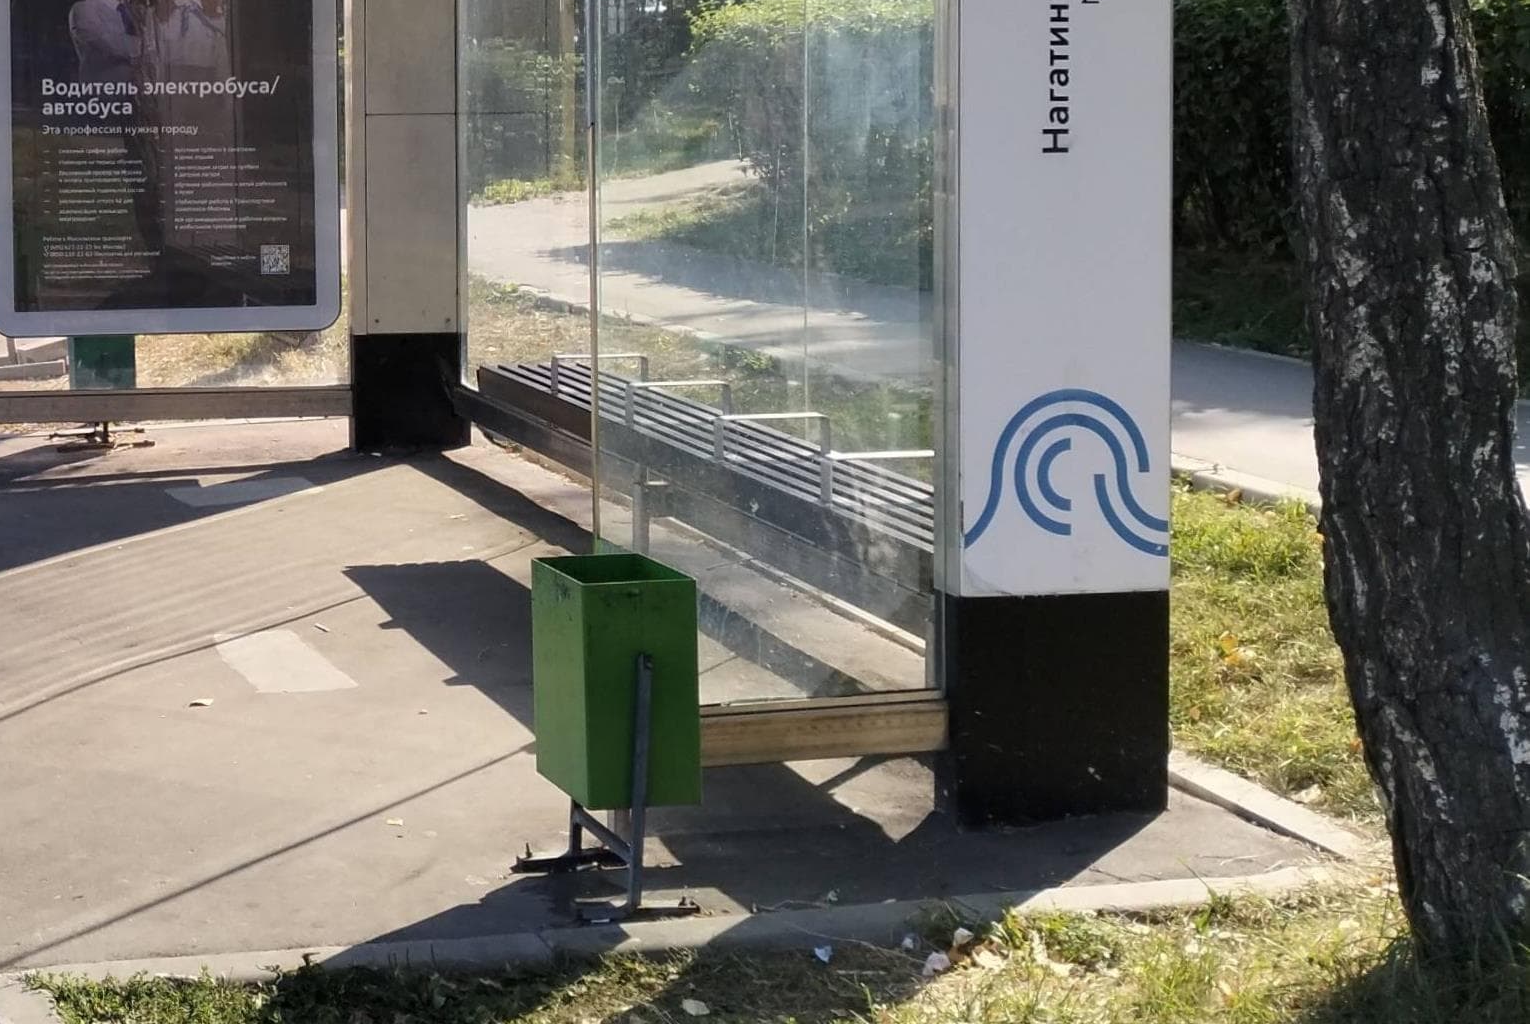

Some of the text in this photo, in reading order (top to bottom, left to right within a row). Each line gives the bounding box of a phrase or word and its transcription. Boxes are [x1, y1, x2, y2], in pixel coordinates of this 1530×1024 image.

[41, 75, 281, 98] Водитель электробуса/
[41, 98, 133, 118] автобуса
[41, 125, 199, 136] Эта профессия нужна городу
